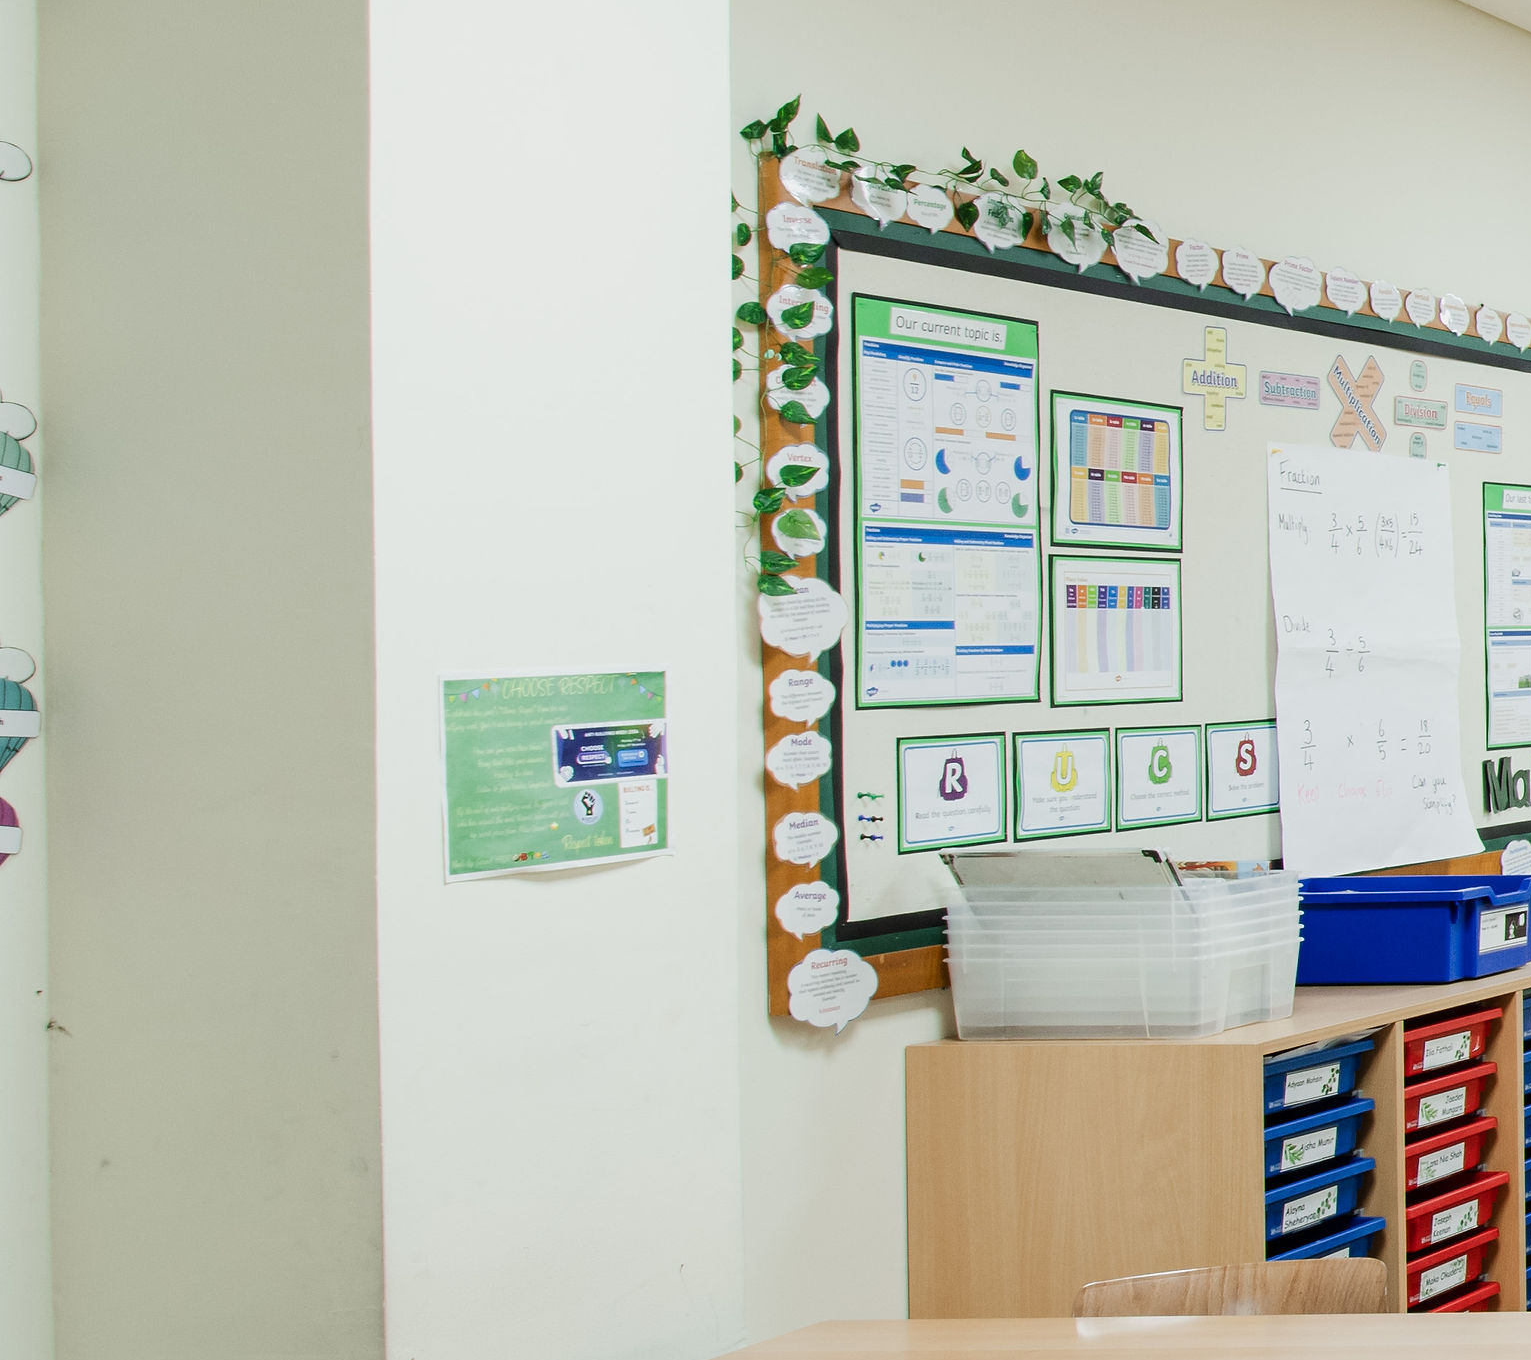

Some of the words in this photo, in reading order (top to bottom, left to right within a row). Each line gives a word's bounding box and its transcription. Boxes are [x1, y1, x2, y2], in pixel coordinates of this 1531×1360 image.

[913, 198, 947, 210] Percentage
[896, 315, 917, 330] Our
[921, 323, 961, 337] current
[965, 328, 989, 342] topic
[992, 331, 1003, 343] is.
[1191, 369, 1238, 390] Addition
[1263, 381, 1317, 400] Subtraction
[1332, 364, 1381, 445] Multiplication
[1465, 392, 1492, 410] Equals
[1403, 404, 1439, 420] Division
[786, 453, 812, 462] Vertex
[1280, 459, 1321, 486] Fraction
[1505, 493, 1516, 505] Our
[1517, 495, 1528, 505] last
[1331, 513, 1338, 528] 3
[1359, 516, 1365, 529] 5
[1410, 513, 1419, 526] 15
[1331, 538, 1339, 554] 4
[1356, 538, 1362, 555] 6
[1409, 540, 1423, 554] 24
[1283, 615, 1311, 633] Divide
[501, 679, 554, 699] CHOOSE
[560, 675, 616, 696] RESPECT
[788, 678, 814, 687] Range
[791, 738, 812, 747] Mode
[1153, 749, 1168, 778] C
[1239, 743, 1253, 771] S
[944, 762, 963, 794] R
[1056, 756, 1072, 785] U
[915, 809, 929, 820] Read
[931, 808, 940, 818] the
[941, 808, 966, 820] question
[789, 819, 819, 830] Median
[794, 892, 827, 901] Average
[811, 957, 848, 970] Recurring
[1434, 1214, 1452, 1228] Joseph
